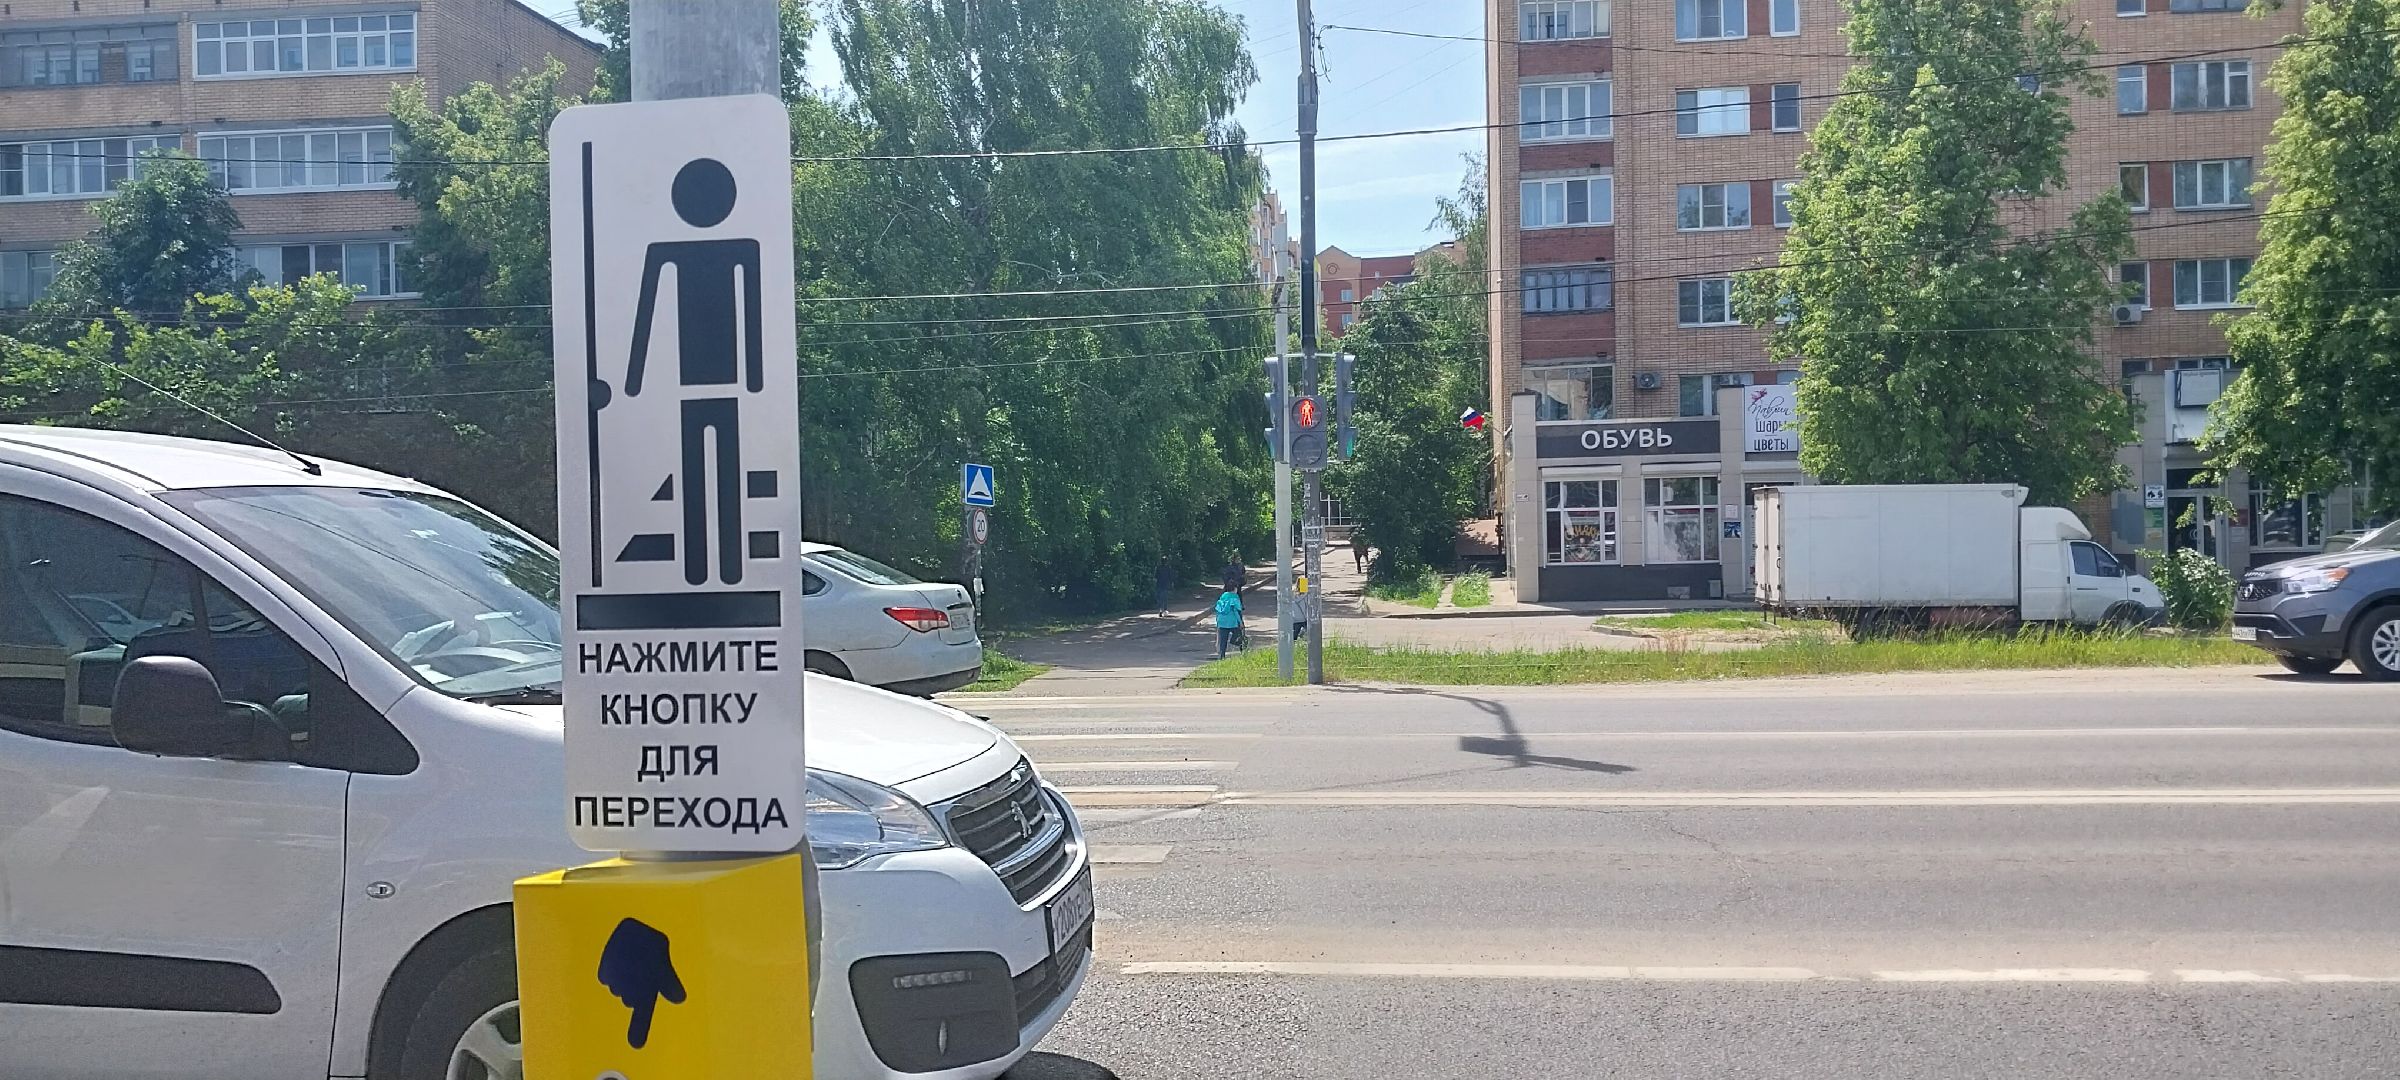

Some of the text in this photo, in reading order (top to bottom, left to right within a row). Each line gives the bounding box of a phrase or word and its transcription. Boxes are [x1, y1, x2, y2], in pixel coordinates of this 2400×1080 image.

[1581, 428, 1673, 449] ОБУВЬ
[977, 519, 986, 532] 20
[578, 640, 779, 674] НАЖМИТЕ
[600, 692, 758, 725] КНОПКУ
[637, 745, 719, 782] ДЛЯ
[574, 796, 789, 834] ПЕРЕХОДА
